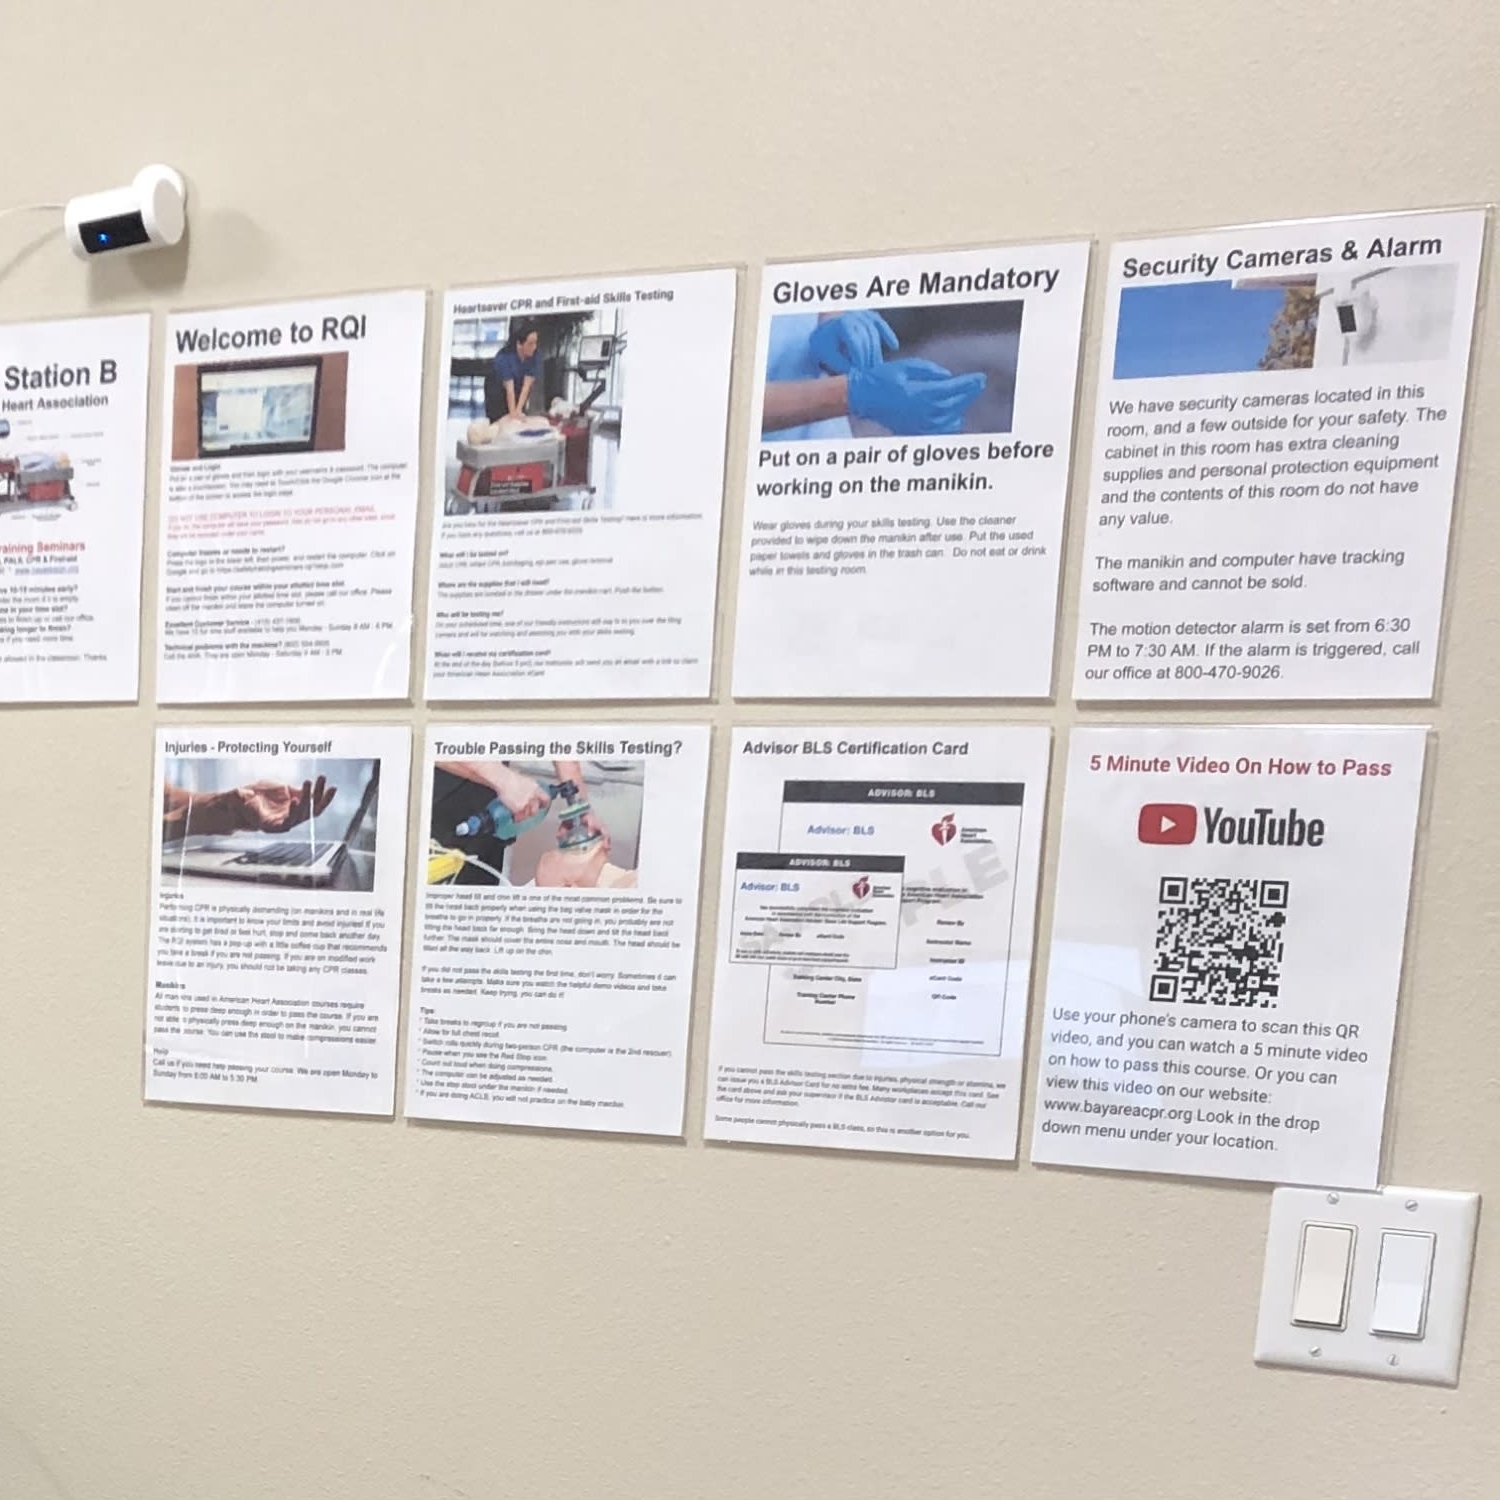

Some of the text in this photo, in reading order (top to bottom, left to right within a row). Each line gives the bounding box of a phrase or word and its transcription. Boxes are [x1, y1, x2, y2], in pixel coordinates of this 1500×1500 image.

[1122, 238, 1442, 279] Security Cameras & Alarm
[772, 268, 1060, 305] Gloves Are Mandatory
[452, 289, 675, 315] Heartsaver CPR and First-aid Skills Testing
[175, 314, 367, 354] Welcome to RQI
[4, 363, 91, 391] Station
[99, 359, 118, 385] B
[1, 398, 34, 413] Heart
[36, 393, 109, 410] Association
[758, 441, 1055, 469] Put on a pair of gloves before
[756, 472, 993, 498] working on the manikin.
[35, 540, 86, 557] Seminars
[1095, 548, 1405, 571] The manikin and computer have tracking
[1092, 574, 1307, 593] software and cannot be sold.
[1089, 617, 1411, 637] The motion detector alarm is set from 6:30
[1087, 640, 1421, 660] PM to 7:30 AM. If the alarm is triggered, call
[1084, 664, 1284, 680] our office at 800-470-9026.
[164, 741, 208, 756] Injuries
[217, 740, 280, 757] Protecting
[282, 740, 333, 754] Yourself
[434, 739, 683, 758] Trouble Passing the Skills Testing?
[742, 740, 970, 756] Advisor BLS Certification Card
[1090, 754, 1392, 777] 5 Minute Video On How to Pass
[915, 788, 936, 799] BLS
[852, 824, 875, 836] BLS
[1203, 806, 1325, 848] YouTube
[832, 858, 851, 868] BLS
[780, 882, 800, 893] BLS
[1052, 1007, 1360, 1040] Use your phone's camera to scan this QR
[1050, 1030, 1369, 1064] video, and you can watch a 5 minute video
[1047, 1053, 1338, 1085] on how to pass this course. Or you can
[1045, 1075, 1272, 1104] view this video on our website:
[1043, 1099, 1320, 1134] www.bayareacpr.org Look in the drop
[1041, 1120, 1277, 1151] down menu under your location.
